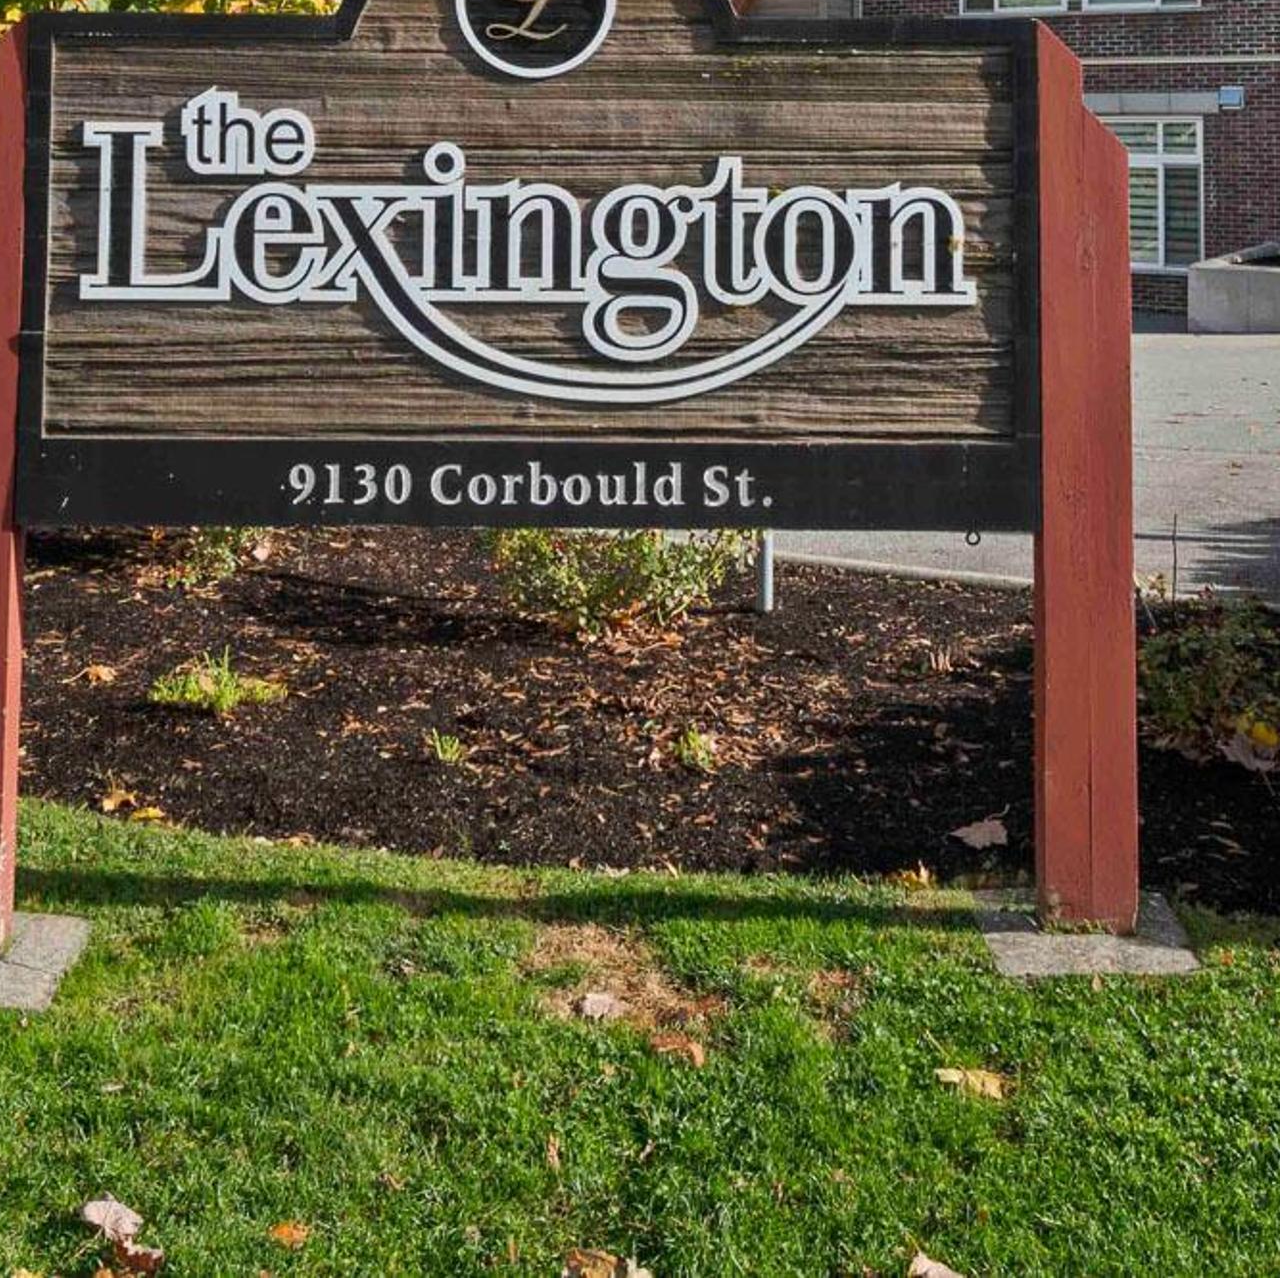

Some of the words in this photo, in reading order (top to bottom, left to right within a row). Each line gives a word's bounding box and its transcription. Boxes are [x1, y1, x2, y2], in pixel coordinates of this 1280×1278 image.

[184, 88, 313, 174] the
[81, 122, 977, 403] Lexington
[288, 462, 413, 506] 9130
[430, 461, 686, 507] Corbould
[703, 465, 774, 508] St.
